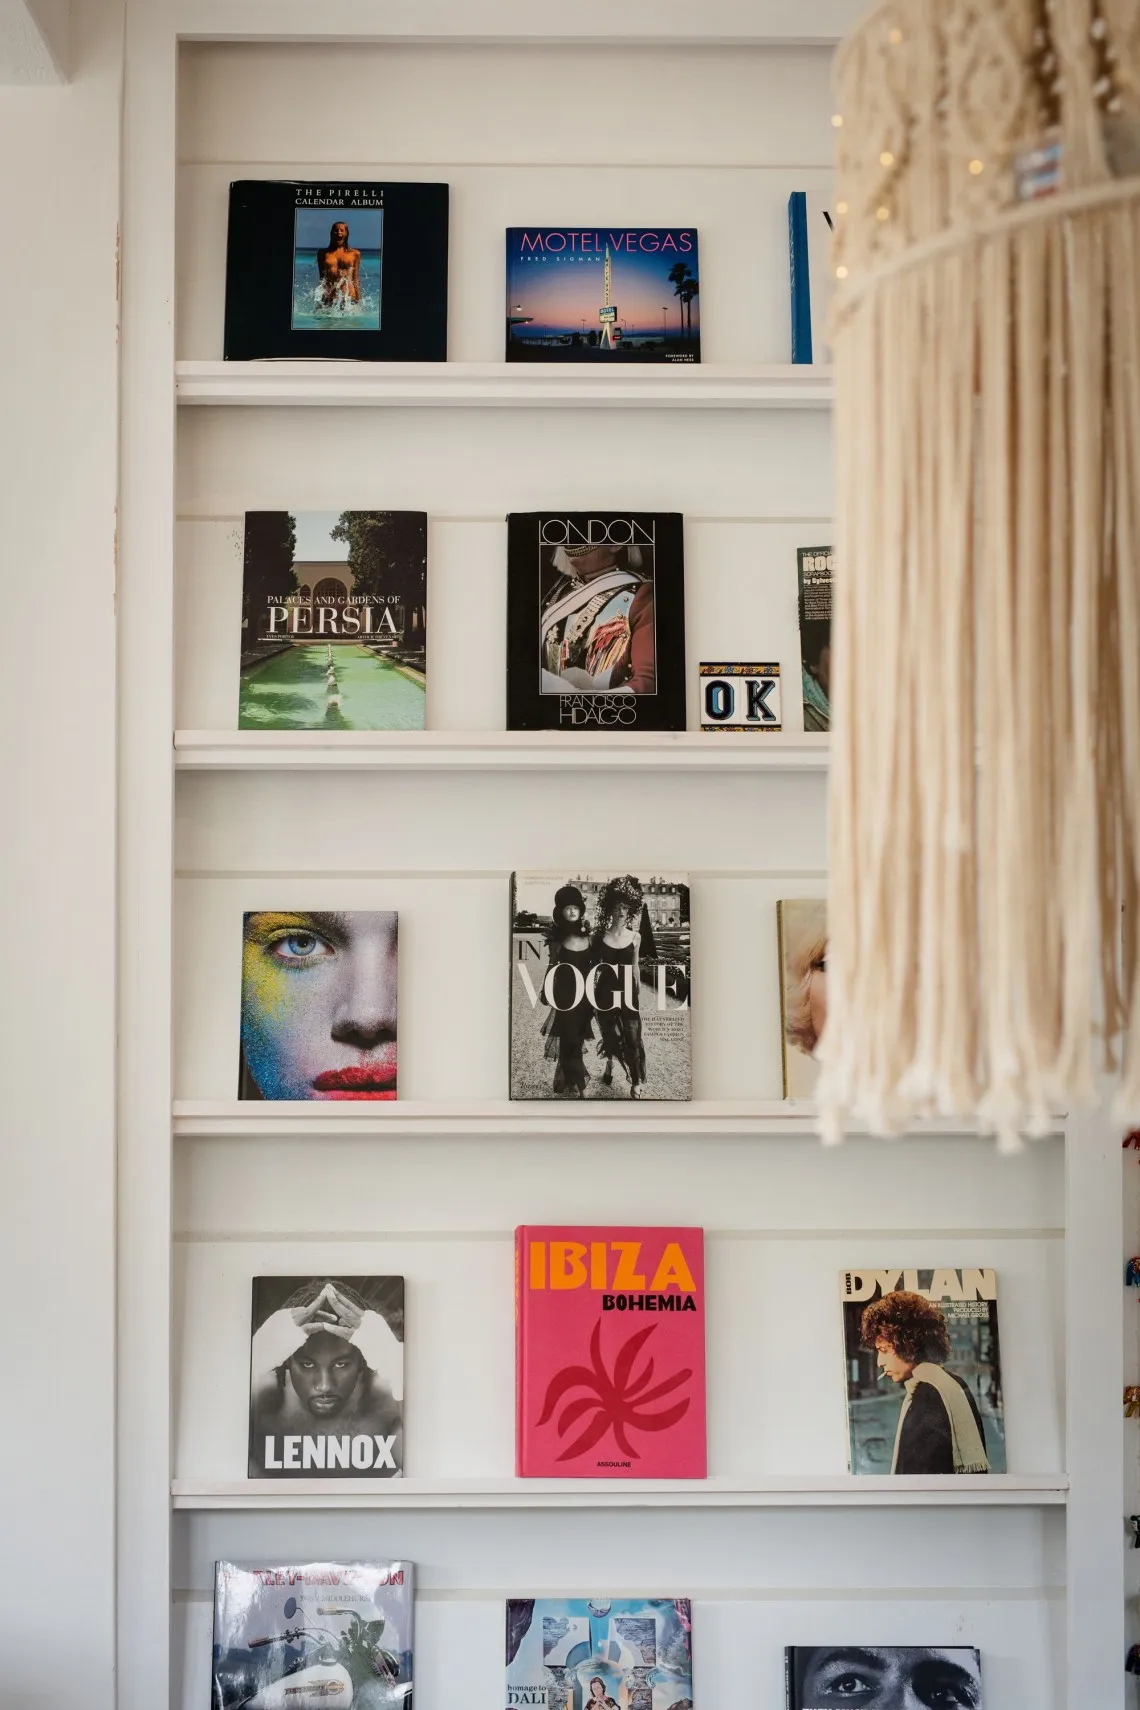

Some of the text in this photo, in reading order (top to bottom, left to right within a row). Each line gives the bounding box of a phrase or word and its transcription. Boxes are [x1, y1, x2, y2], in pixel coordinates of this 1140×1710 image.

[295, 198, 345, 206] CALENDAR
[520, 232, 692, 252] MOTEL VEGAS
[539, 519, 655, 544] LONDON
[803, 555, 838, 571] ROC
[267, 595, 401, 605] PALACES AND GARDENS OF
[265, 606, 402, 634] PERSIA
[559, 695, 636, 708] FRANCISCO
[559, 707, 636, 724] HIDALGO
[517, 940, 542, 961] IN
[515, 962, 689, 1012] VOGUE
[529, 1241, 697, 1292] IBIZA
[849, 1269, 995, 1301] DYLAN
[602, 1294, 697, 1312] BOHEMIA
[264, 1434, 397, 1470] LENNOX
[507, 1684, 538, 1692] homage
[508, 1692, 547, 1705] DALI
